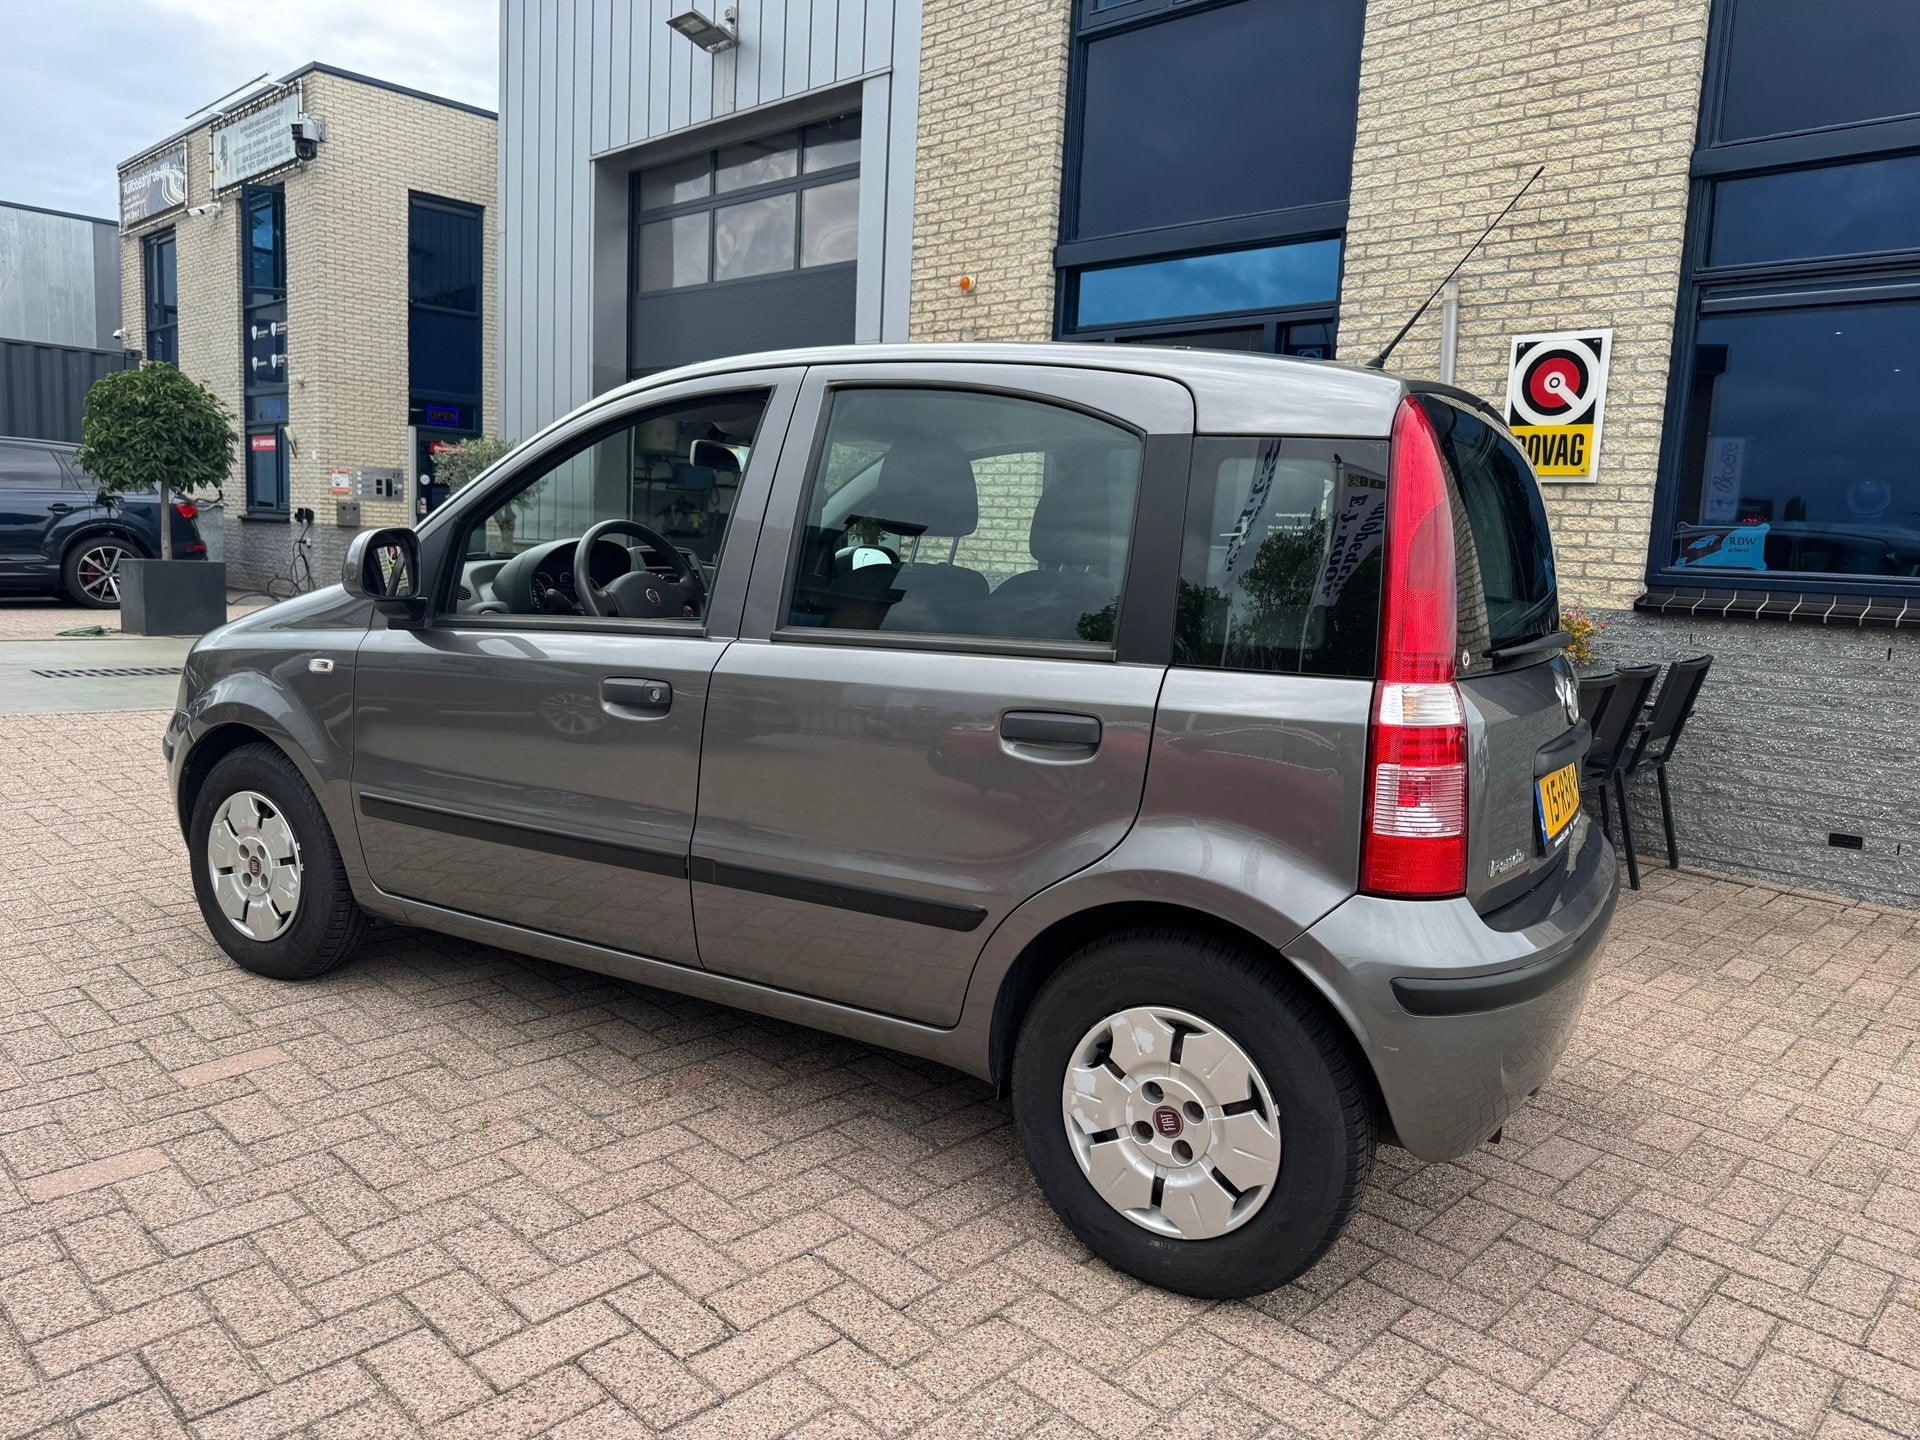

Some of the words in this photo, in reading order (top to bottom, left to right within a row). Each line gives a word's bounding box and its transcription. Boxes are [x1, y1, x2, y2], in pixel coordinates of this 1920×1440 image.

[430, 410, 456, 422] OPEN
[1729, 536, 1757, 546] RDW
[1160, 1114, 1176, 1131] FIAT
